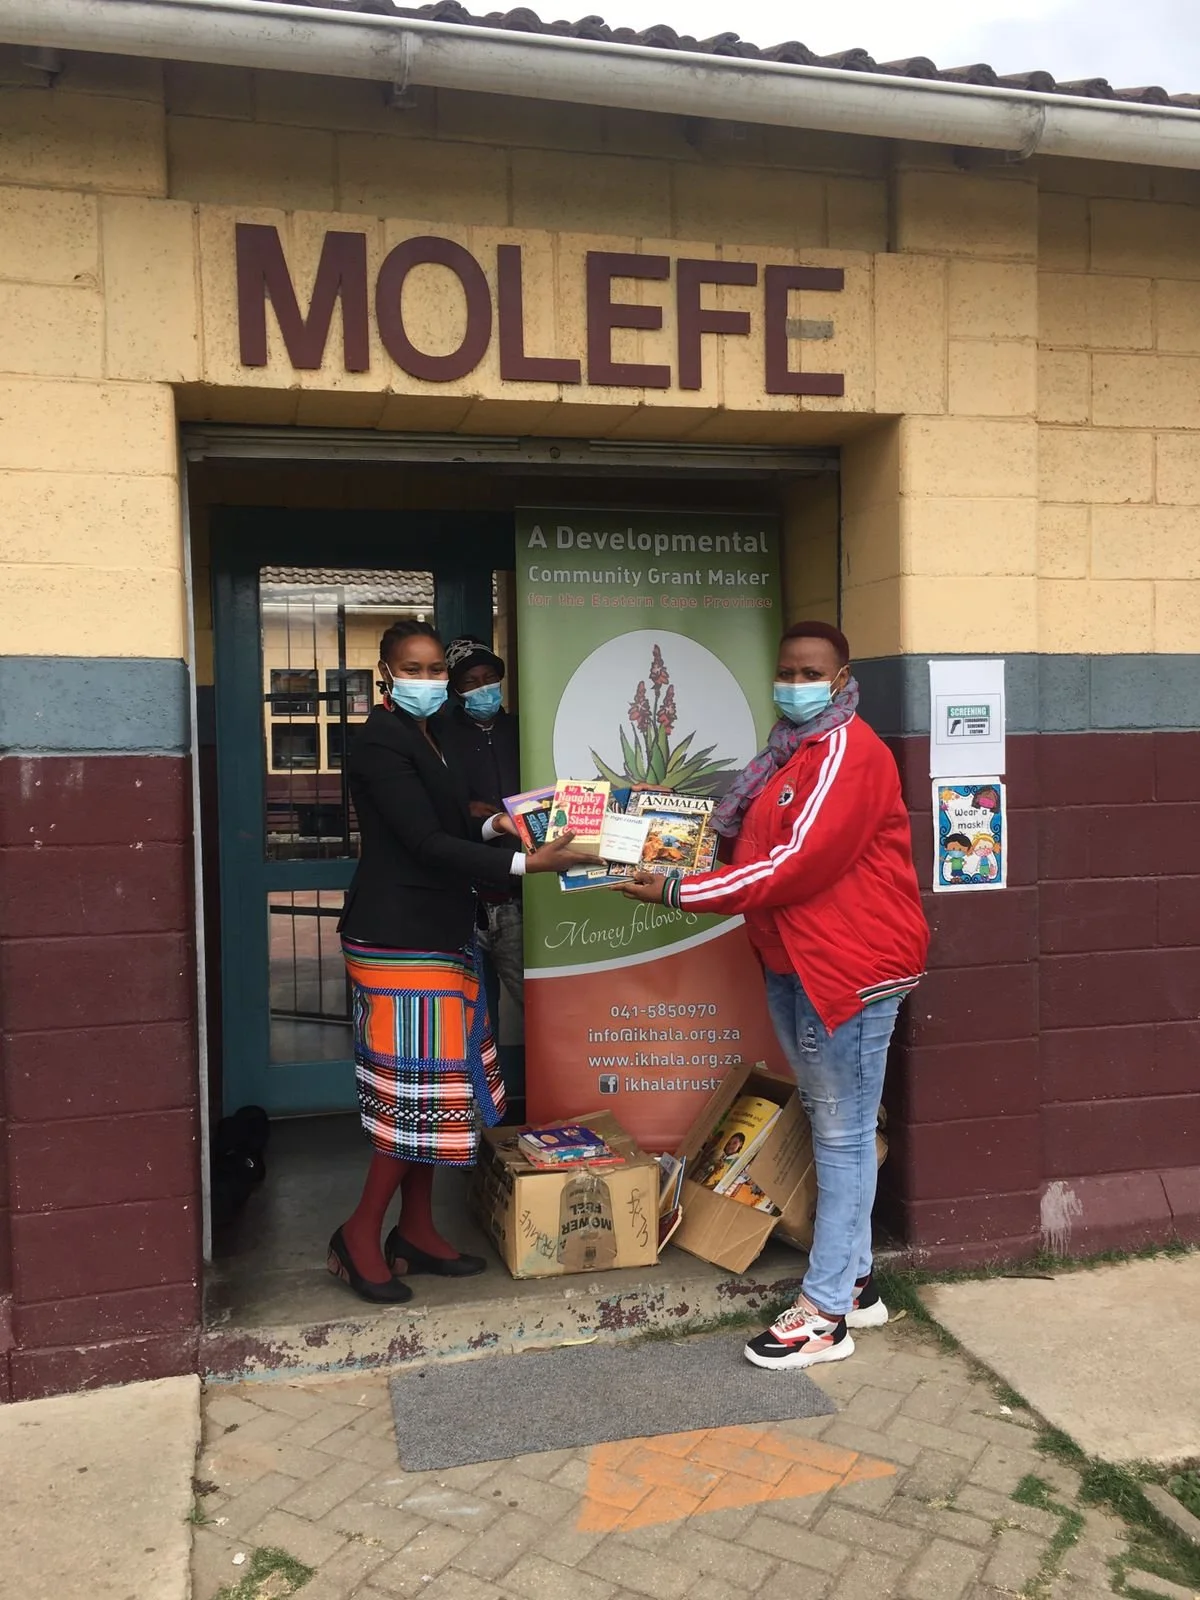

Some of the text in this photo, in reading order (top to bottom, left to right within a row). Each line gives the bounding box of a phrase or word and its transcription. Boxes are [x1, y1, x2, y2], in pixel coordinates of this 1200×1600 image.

[235, 222, 844, 397] MOLEFE
[527, 524, 769, 556] A Developmental
[528, 565, 769, 587] Community Grant Maker
[527, 592, 773, 612] for the Eastern Cape Province
[950, 707, 987, 717] SCREENING
[558, 791, 602, 806] Naughty
[641, 795, 710, 812] ANIMALIA
[571, 804, 602, 815] Little
[954, 808, 988, 817] Wear a
[569, 815, 602, 826] Sister
[957, 820, 984, 829] mask!
[544, 902, 683, 949] Money follows
[610, 1003, 717, 1019] 041-5850970
[588, 1028, 740, 1043] info@ikhala.org.za
[588, 1052, 742, 1068] www.ikhala.org.za
[561, 1216, 612, 1236] MOWER
